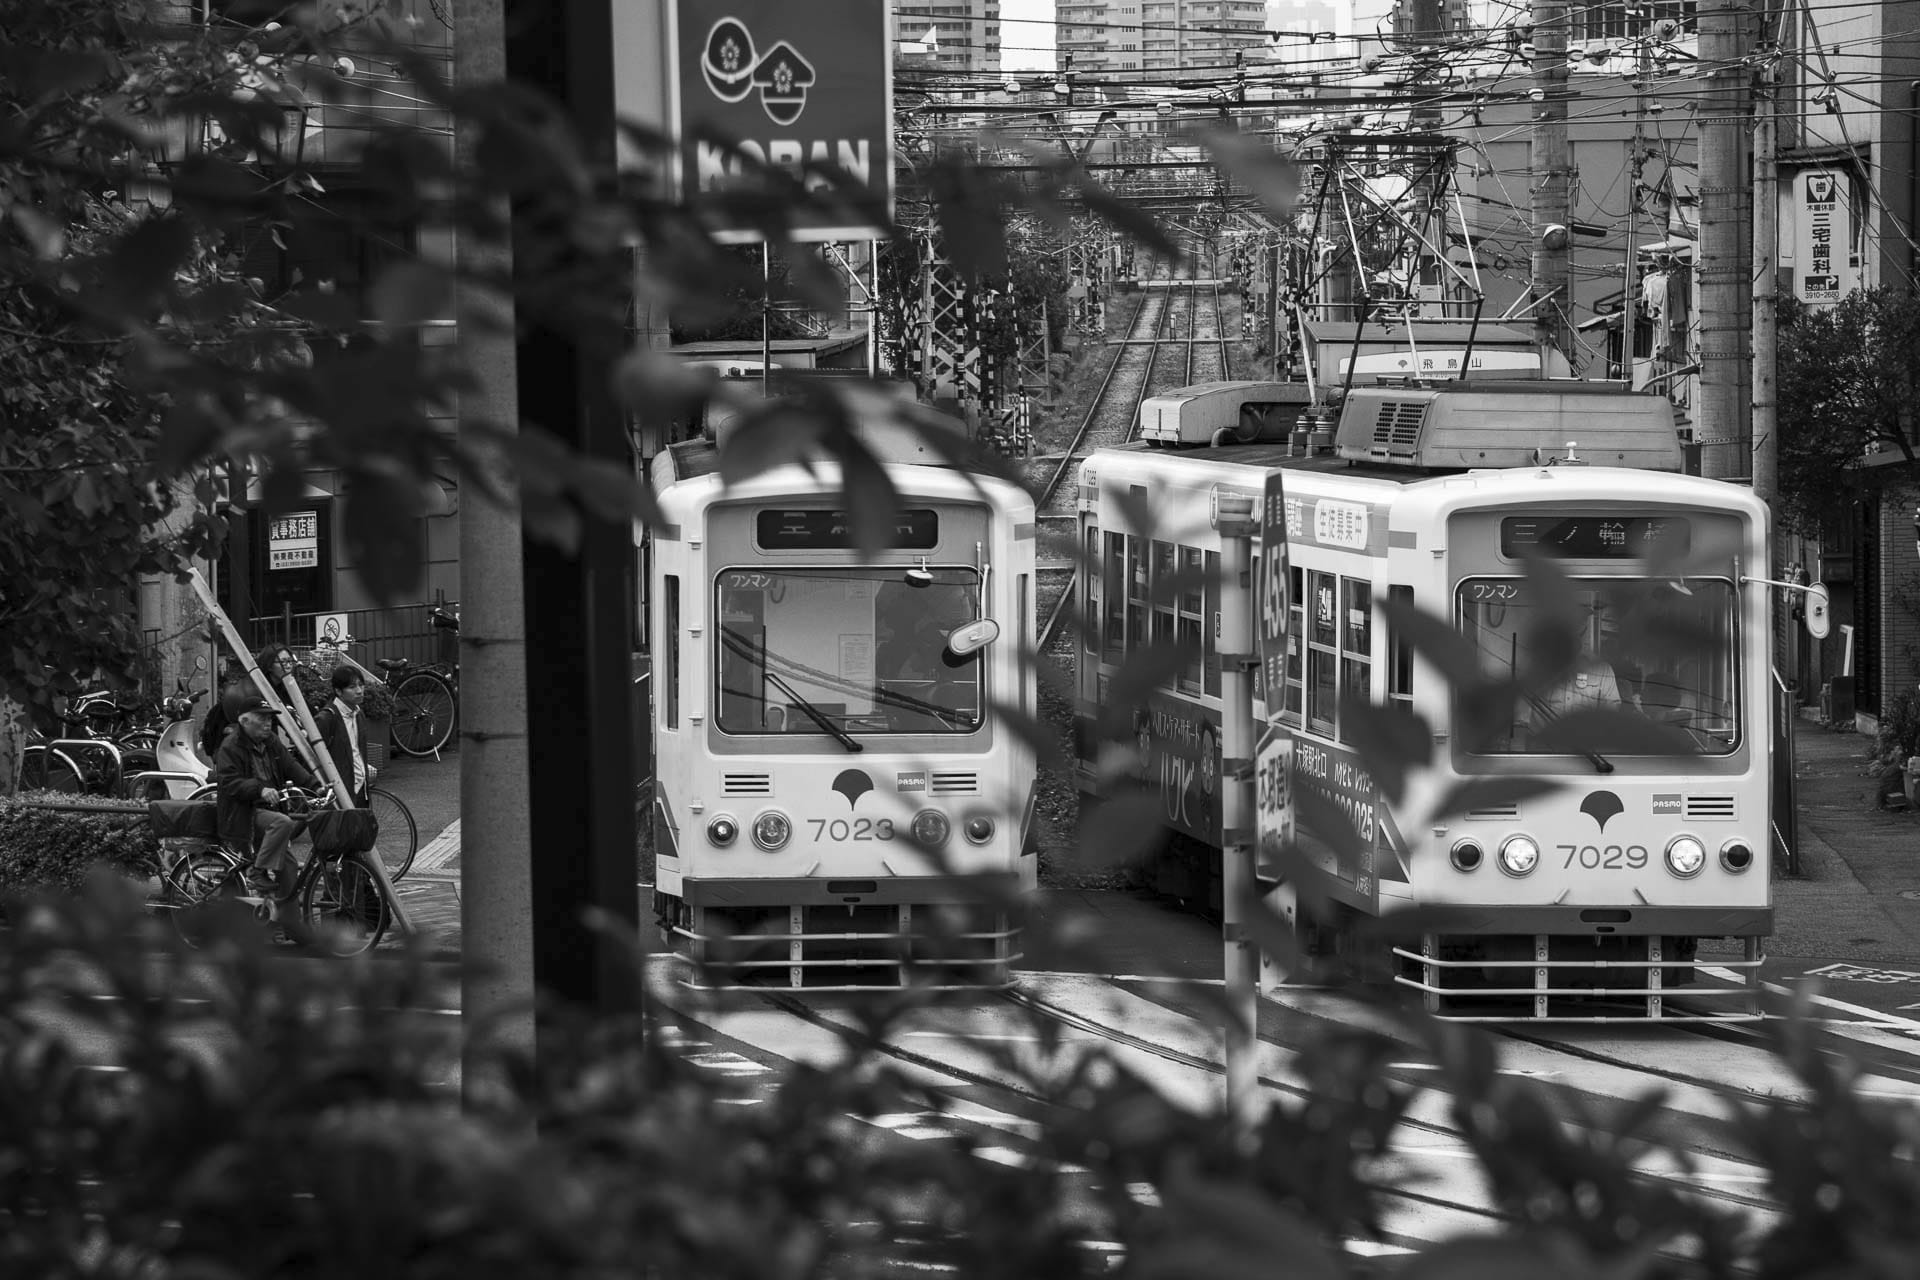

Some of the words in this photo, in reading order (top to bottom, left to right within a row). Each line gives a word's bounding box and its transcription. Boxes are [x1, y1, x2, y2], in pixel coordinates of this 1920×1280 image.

[1812, 213, 1831, 274] 三宅歯科
[1423, 357, 1482, 369] 飛鳥山
[1319, 504, 1363, 544] 生徒募集中
[731, 574, 771, 588] ワンマン
[1264, 542, 1288, 640] 455
[1473, 584, 1518, 599] ワンマン
[1653, 800, 1681, 808] PASMO
[807, 818, 896, 842] 7023
[1556, 845, 1649, 870] 7029
